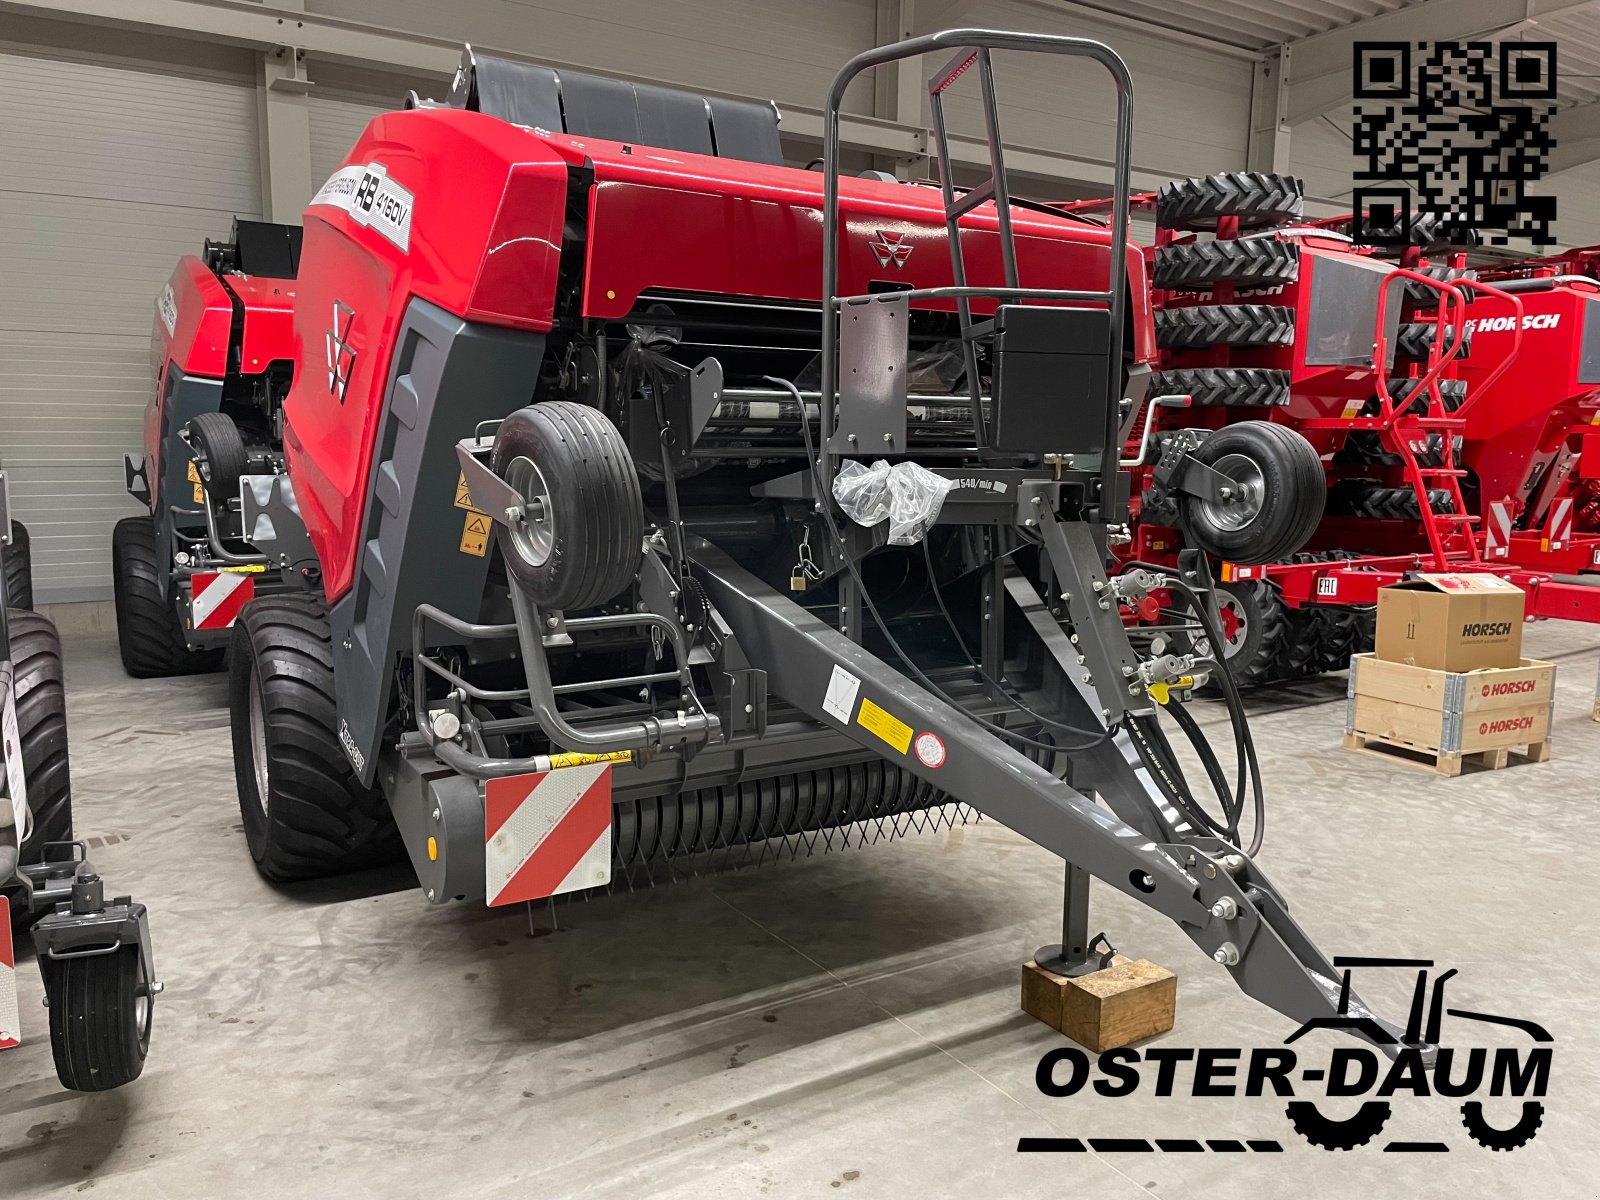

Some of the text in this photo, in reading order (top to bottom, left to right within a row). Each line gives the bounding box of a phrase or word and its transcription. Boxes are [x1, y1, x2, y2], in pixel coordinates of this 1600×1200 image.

[354, 172, 380, 212] RB
[376, 192, 408, 227] 4160V
[960, 478, 992, 490] 540/min
[1462, 622, 1512, 637] HORSCH
[1491, 680, 1536, 696] HORSCH
[1488, 716, 1534, 734] HORSCH
